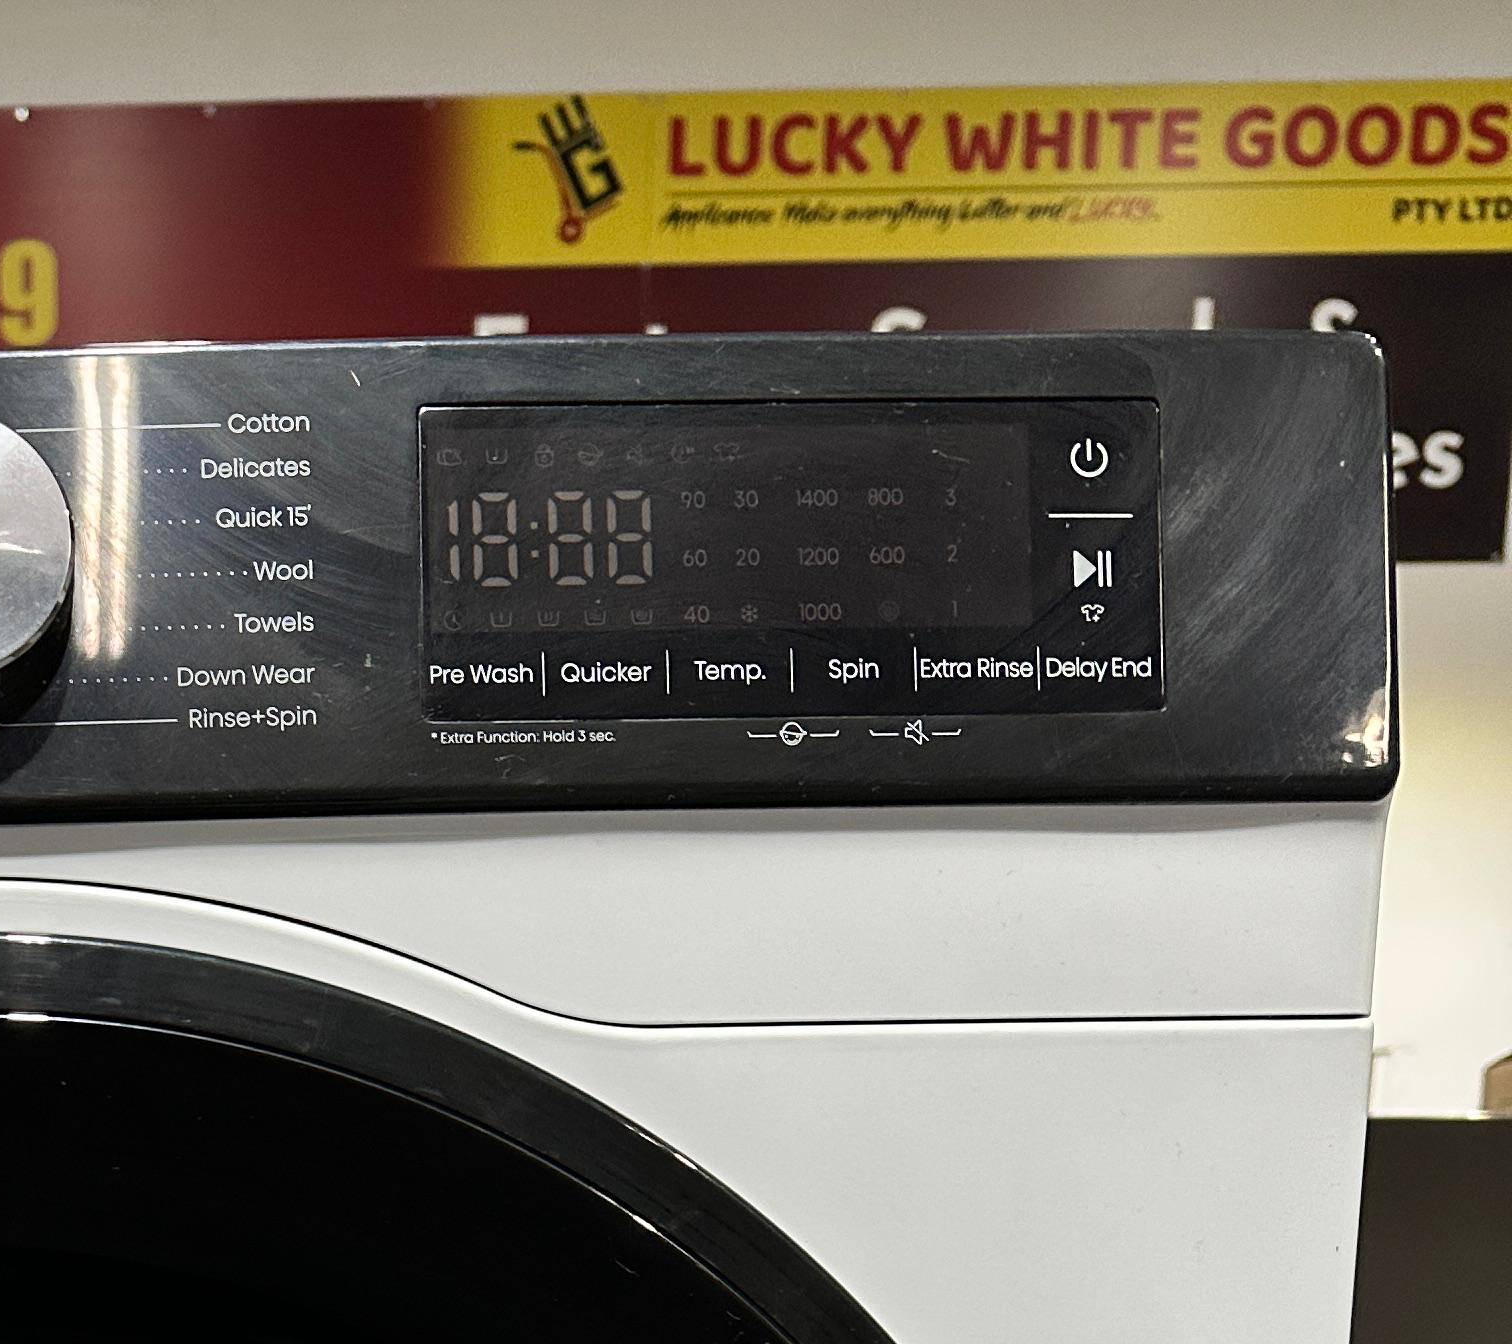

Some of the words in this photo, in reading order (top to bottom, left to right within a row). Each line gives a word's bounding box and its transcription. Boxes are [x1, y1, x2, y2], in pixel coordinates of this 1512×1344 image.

[668, 112, 922, 176] LUCKY
[944, 107, 1202, 172] WHITE
[1225, 102, 1510, 169] GOODS
[1392, 196, 1452, 224] PTY
[1459, 195, 1512, 222] LTD
[227, 412, 311, 434] Cotton
[199, 457, 312, 479] Delicates
[681, 490, 706, 510] 90
[734, 489, 759, 509] 30
[796, 488, 839, 508] 1400
[867, 487, 904, 507] 800
[945, 487, 958, 507] 3
[215, 506, 283, 529] Quick
[682, 548, 708, 567] 60
[735, 547, 760, 567] 20
[798, 547, 840, 567] 1200
[869, 545, 905, 565] 600
[947, 544, 959, 563] 2
[252, 559, 314, 582] Wool
[233, 611, 315, 633] Towels
[684, 605, 710, 624] 40
[799, 602, 842, 622] 1000
[176, 665, 246, 687] Down
[251, 664, 316, 685] Wear
[429, 664, 465, 685] Pre
[469, 662, 534, 684] Wash
[560, 661, 653, 684] Quicker
[693, 660, 767, 686] Temp.
[828, 657, 880, 684] Spin
[920, 658, 972, 679] Extra
[977, 657, 1034, 679] Rinse
[1045, 656, 1108, 683] Delay
[1112, 656, 1152, 678] End
[188, 705, 317, 732] Rinse+Spin
[440, 731, 474, 745] Extra
[476, 730, 541, 744] Function:
[543, 729, 575, 743] Hold
[577, 730, 586, 742] 3
[588, 730, 616, 742] sec.
